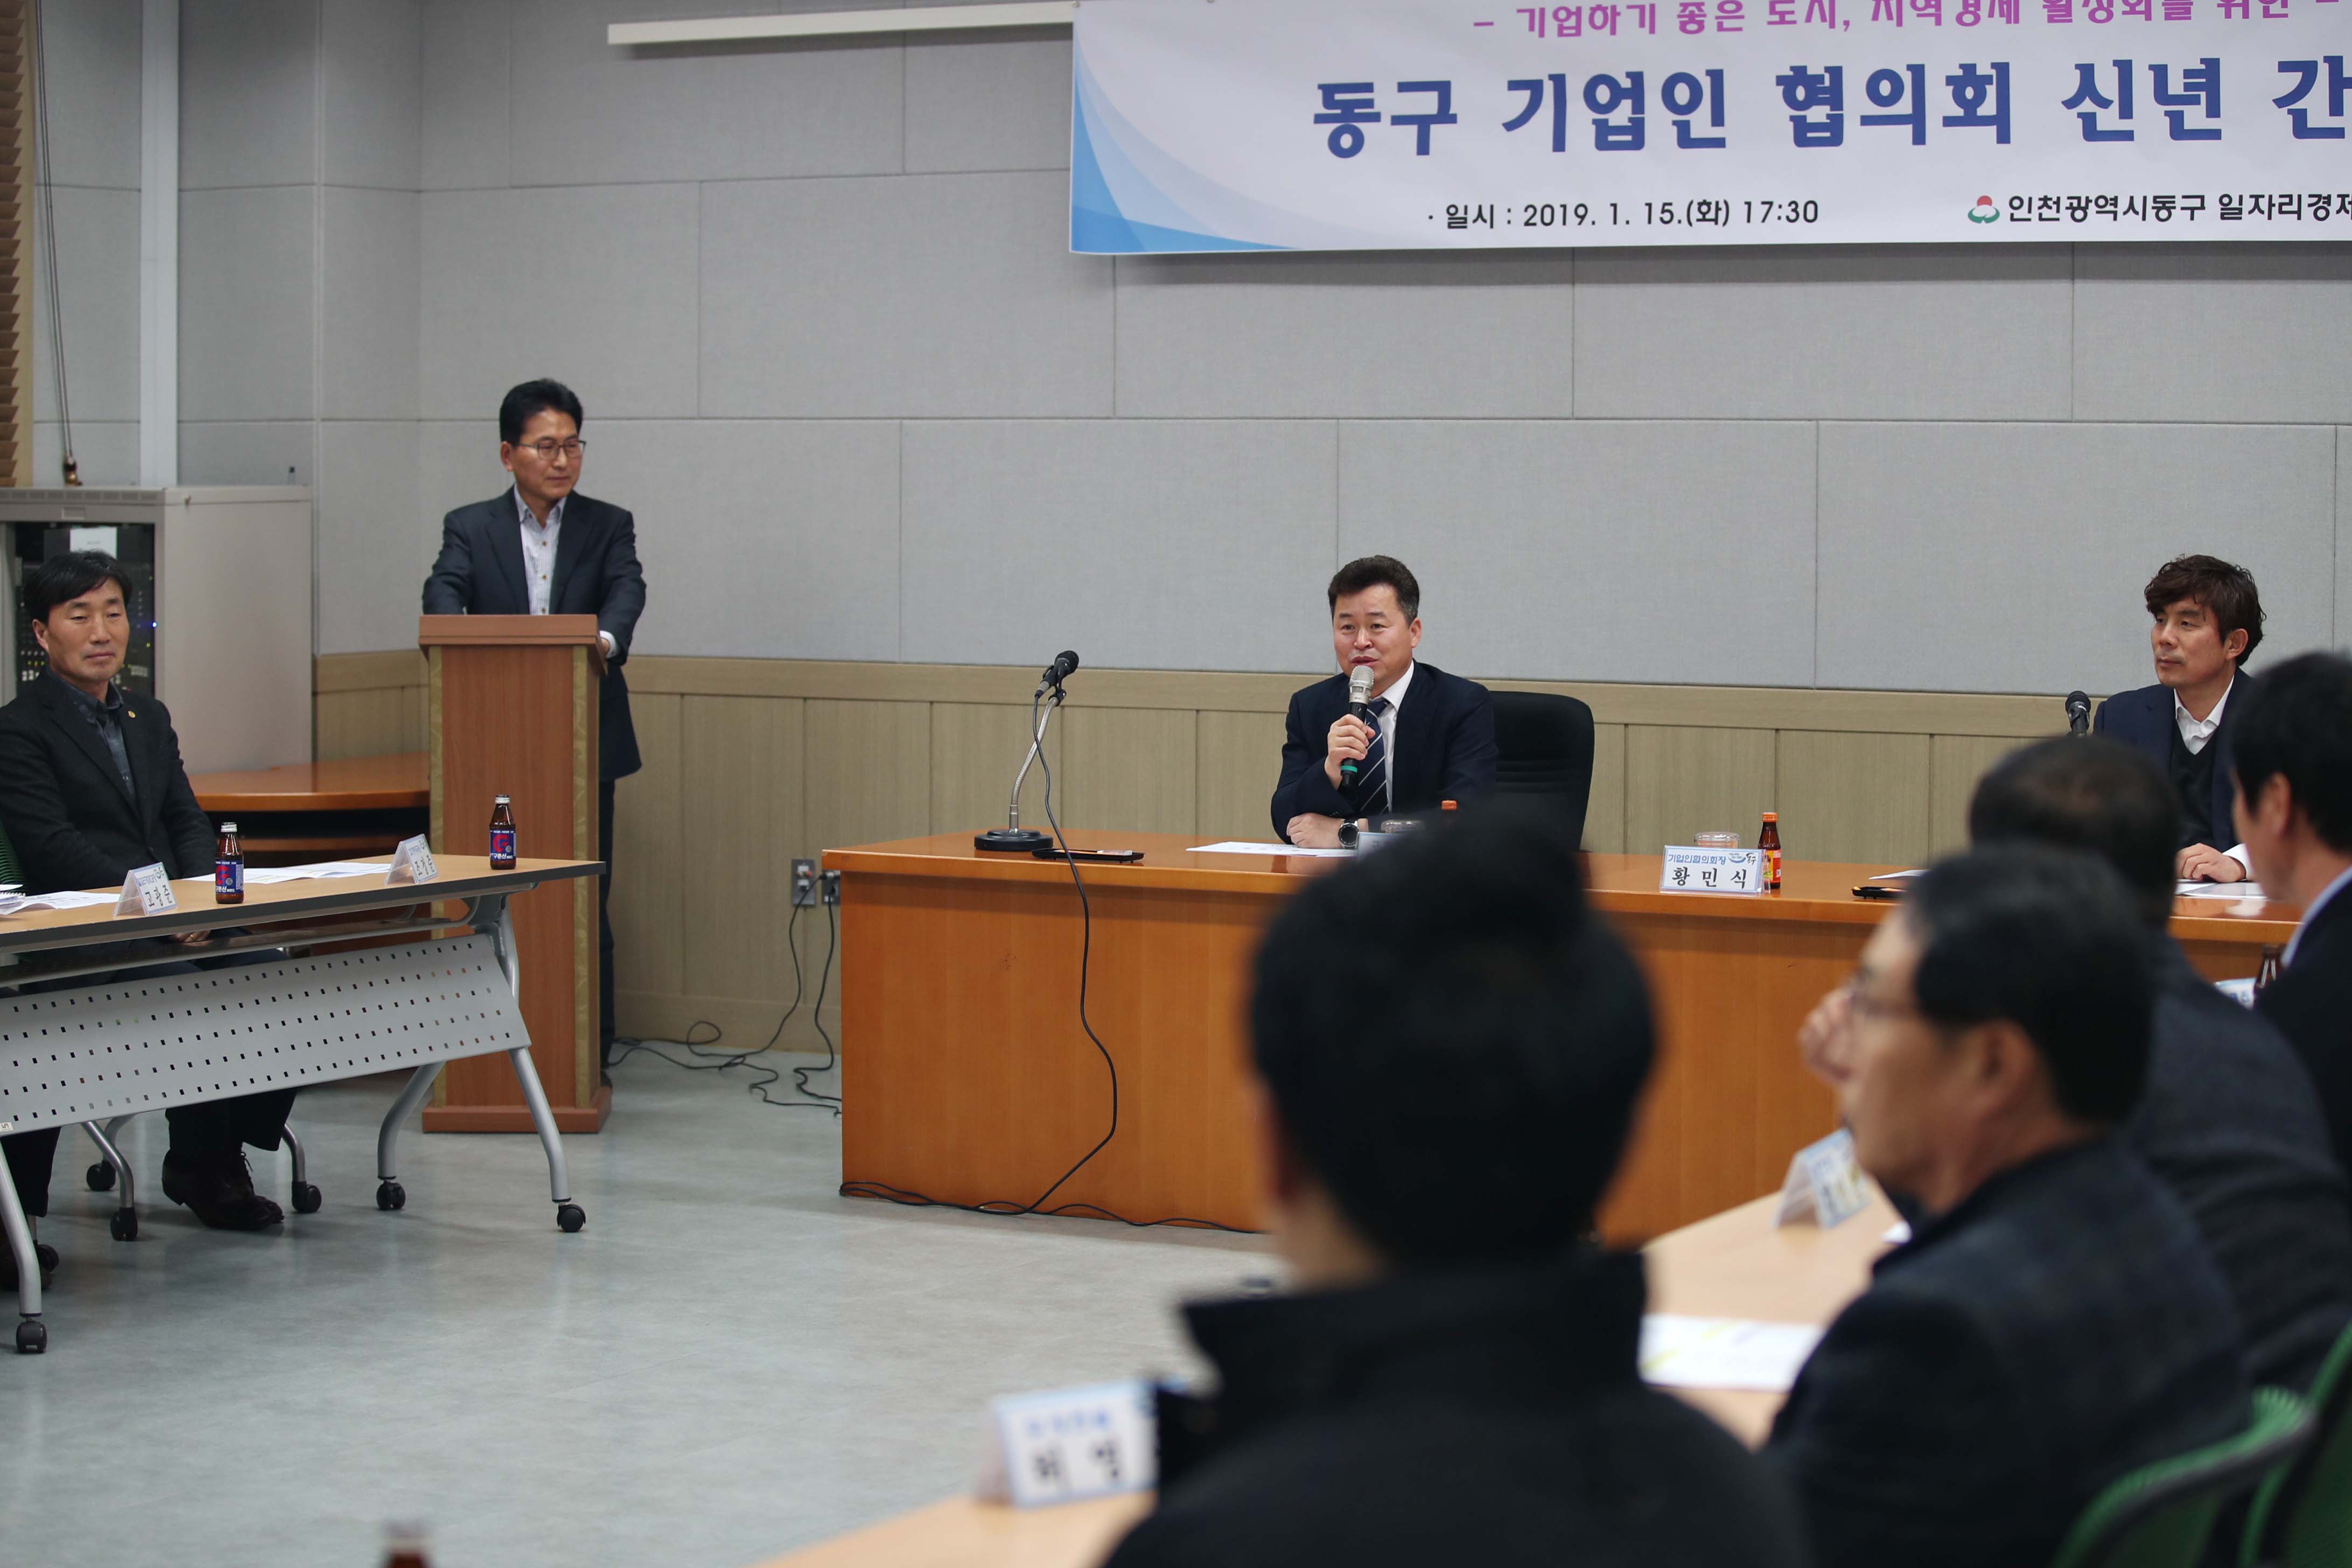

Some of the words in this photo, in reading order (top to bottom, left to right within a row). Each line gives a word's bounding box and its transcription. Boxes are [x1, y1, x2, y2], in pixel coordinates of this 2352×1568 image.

[1516, 4, 1657, 39] 기업하기
[1677, 1, 1746, 36] 좋은
[1314, 81, 1458, 159] 동구
[1503, 69, 1726, 153] 기업인
[1776, 62, 2011, 148] 협의회
[2062, 58, 2222, 142] 신년
[2272, 55, 2352, 139] 간
[1446, 204, 1495, 230] 일시
[1524, 204, 1597, 227] 2019.
[1744, 200, 1818, 224] 17:30
[2009, 195, 2206, 223] 인천광역시동구
[1668, 853, 1726, 865] 기업인협의회장
